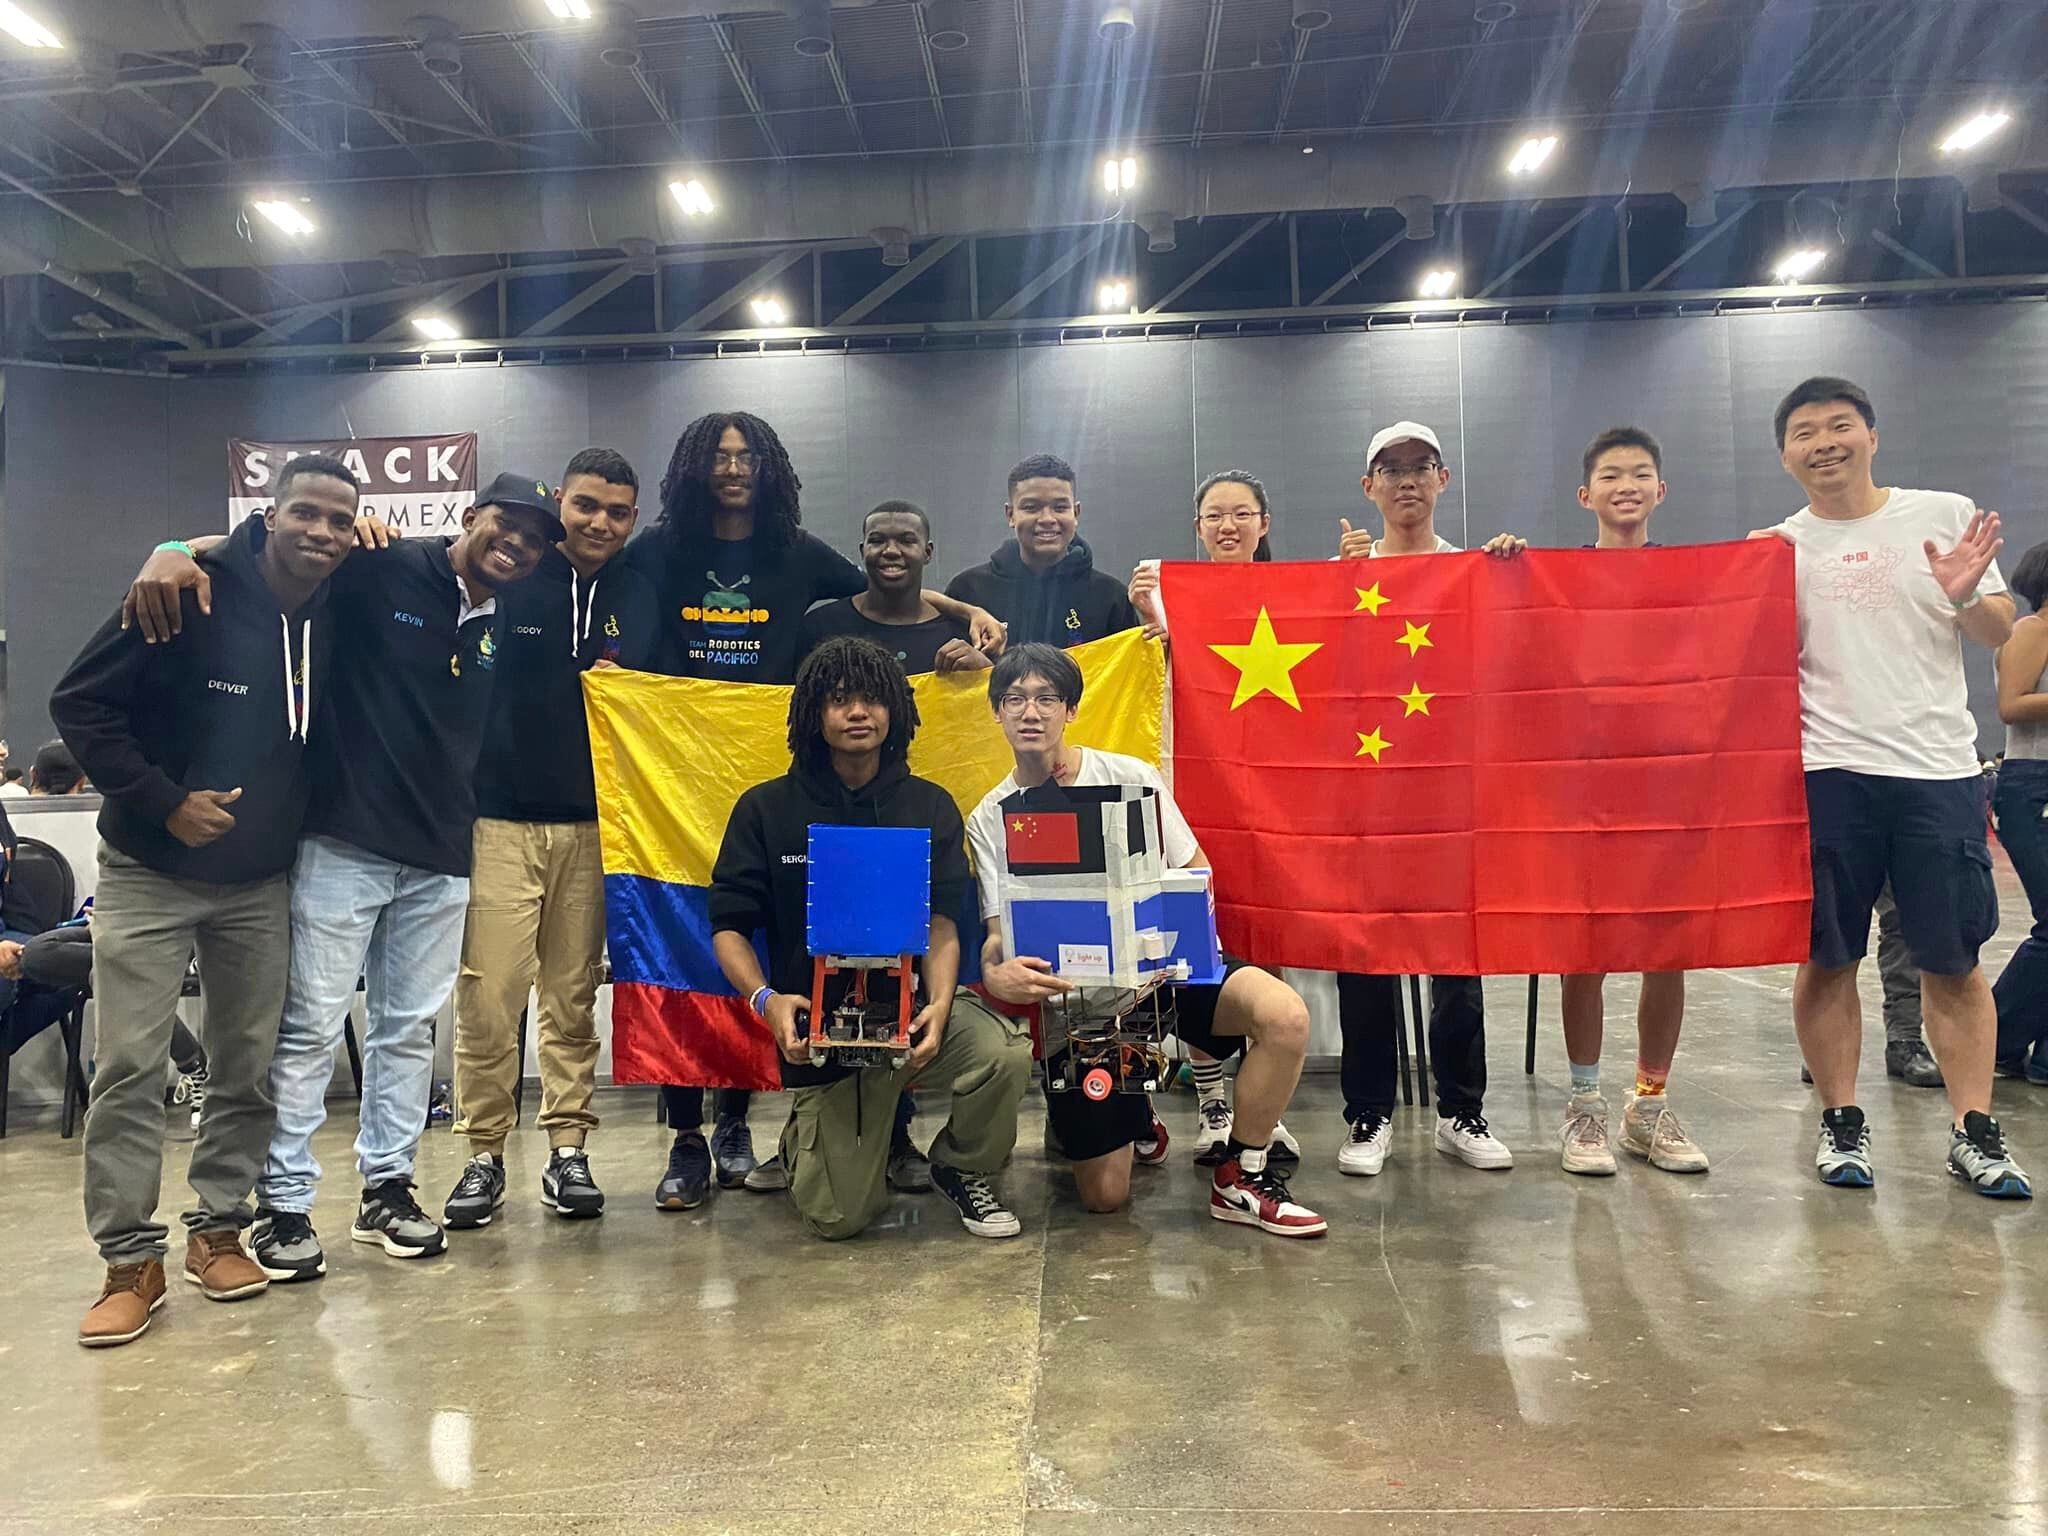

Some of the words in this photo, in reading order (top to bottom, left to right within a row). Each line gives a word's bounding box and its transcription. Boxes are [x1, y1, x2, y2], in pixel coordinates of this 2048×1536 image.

[244, 445, 459, 487] SACK
[1842, 551, 1868, 563] 中国
[394, 610, 424, 628] KEVIN
[708, 639, 761, 650] ROBOTICS
[688, 650, 706, 659] DEL
[208, 679, 249, 696] DEIVER
